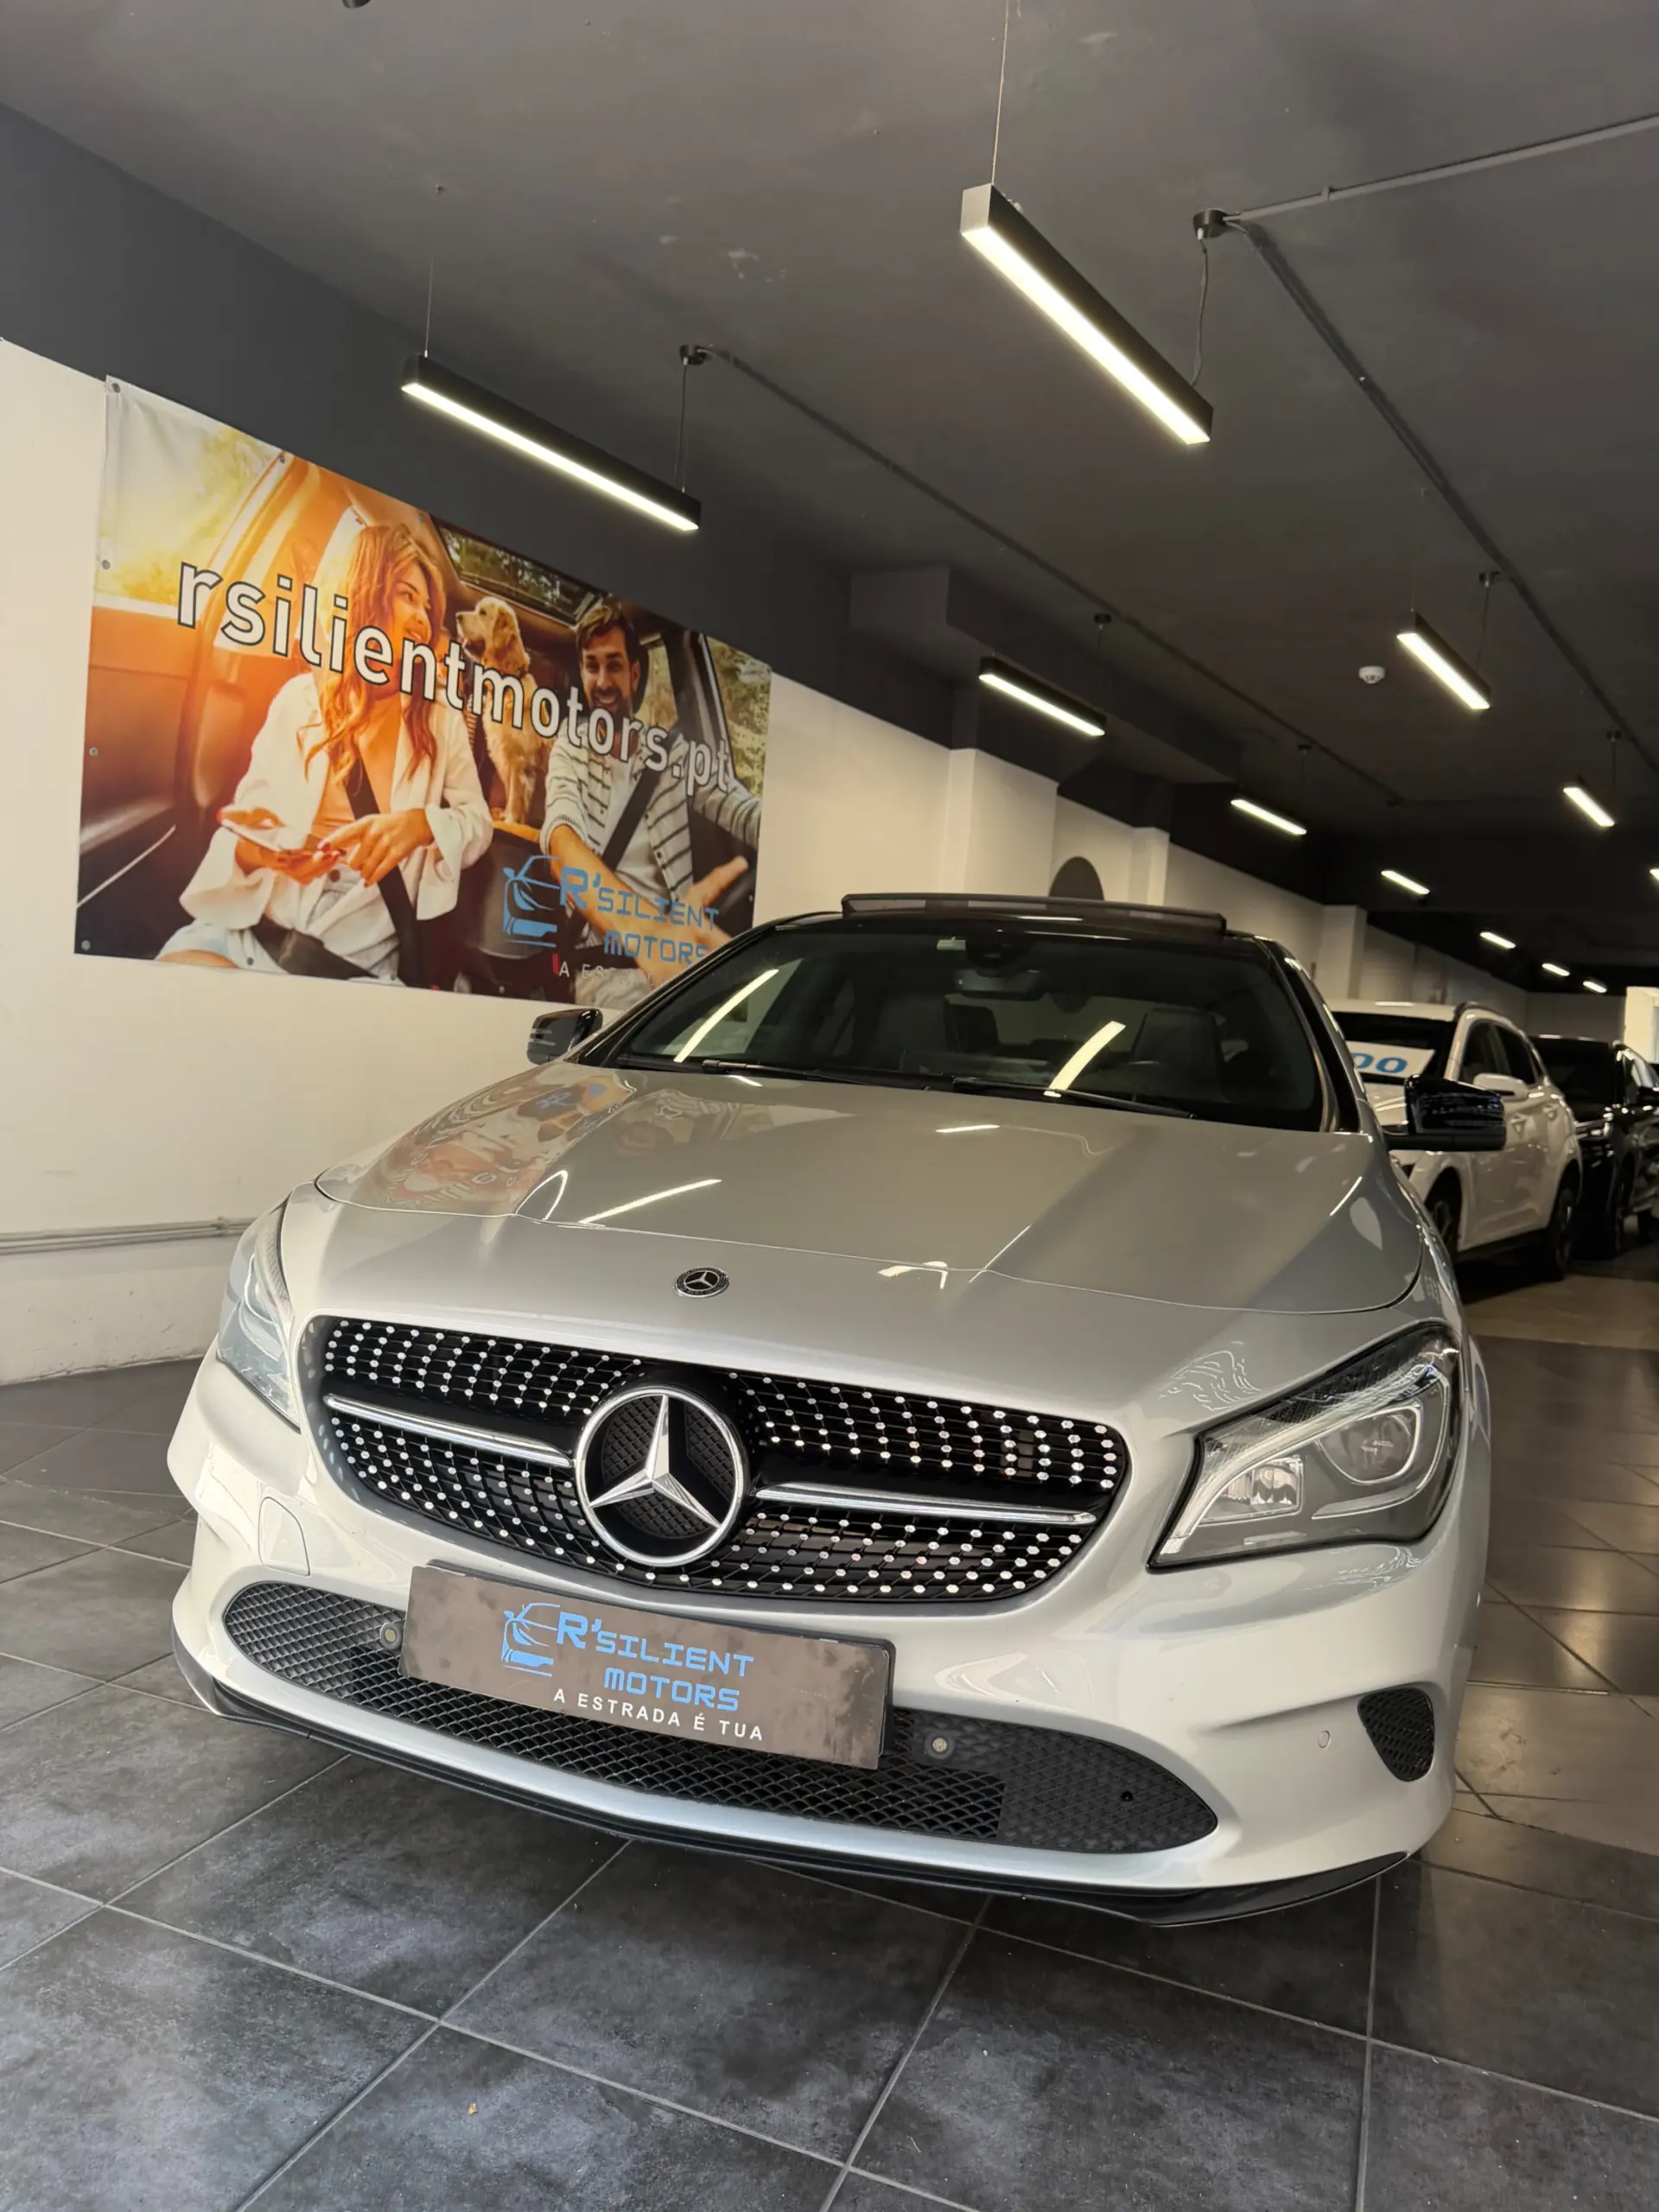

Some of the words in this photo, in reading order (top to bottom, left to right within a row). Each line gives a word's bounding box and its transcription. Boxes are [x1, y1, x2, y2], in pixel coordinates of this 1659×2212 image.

[177, 562, 729, 798] rsilientmotors.pt
[556, 1611, 754, 1677] R'SILIENT
[554, 1688, 565, 1703] A
[577, 1693, 680, 1726] ESTRADA
[694, 1713, 705, 1732] É
[719, 1719, 763, 1741] TUA
[604, 1668, 740, 1712] MOTORS
